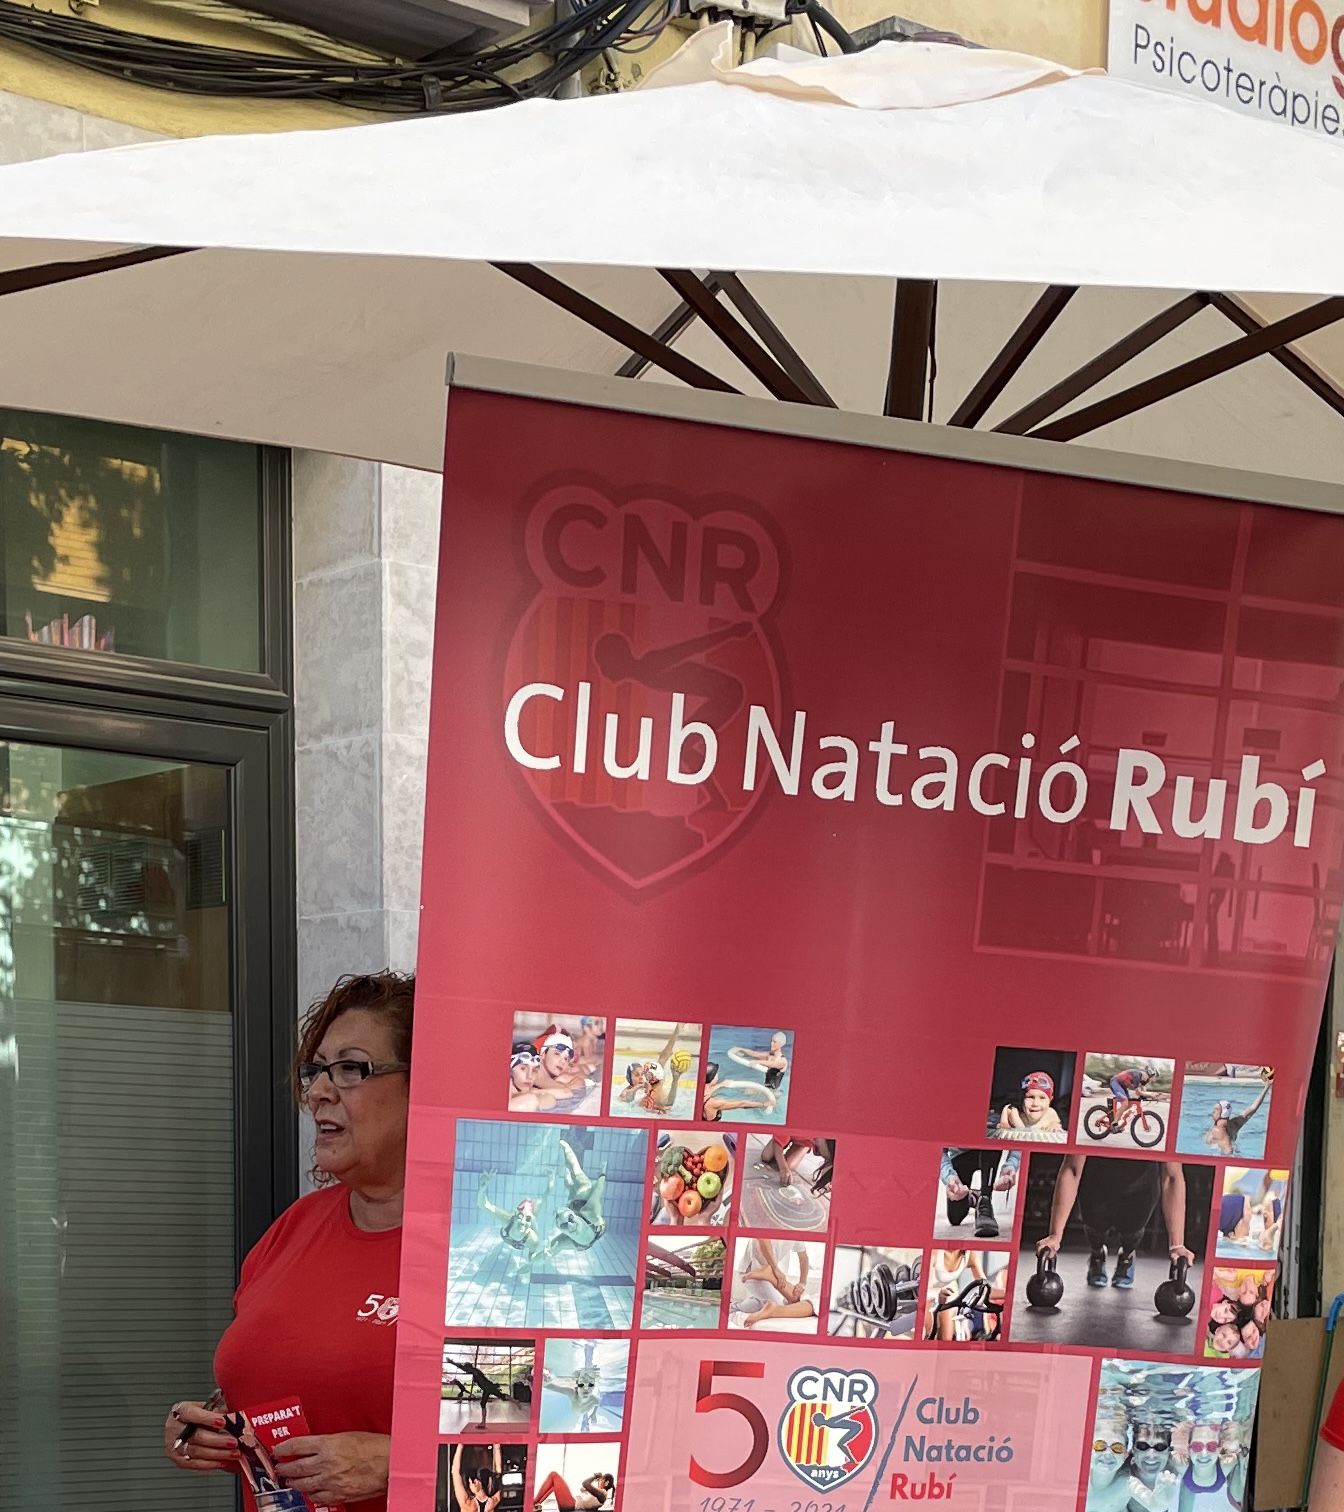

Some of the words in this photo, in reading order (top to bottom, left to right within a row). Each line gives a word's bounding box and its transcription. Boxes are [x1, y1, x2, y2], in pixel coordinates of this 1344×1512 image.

[540, 500, 761, 613] CNR
[503, 681, 718, 786] Club
[742, 704, 1087, 825] Natació
[1108, 746, 1326, 848] Rubí
[797, 1376, 869, 1403] CNR
[252, 1405, 302, 1428] PREPARA'T
[916, 1397, 980, 1425] Club
[903, 1435, 1014, 1463] Natació
[809, 1467, 840, 1480] anys
[890, 1472, 957, 1500] Rubí
